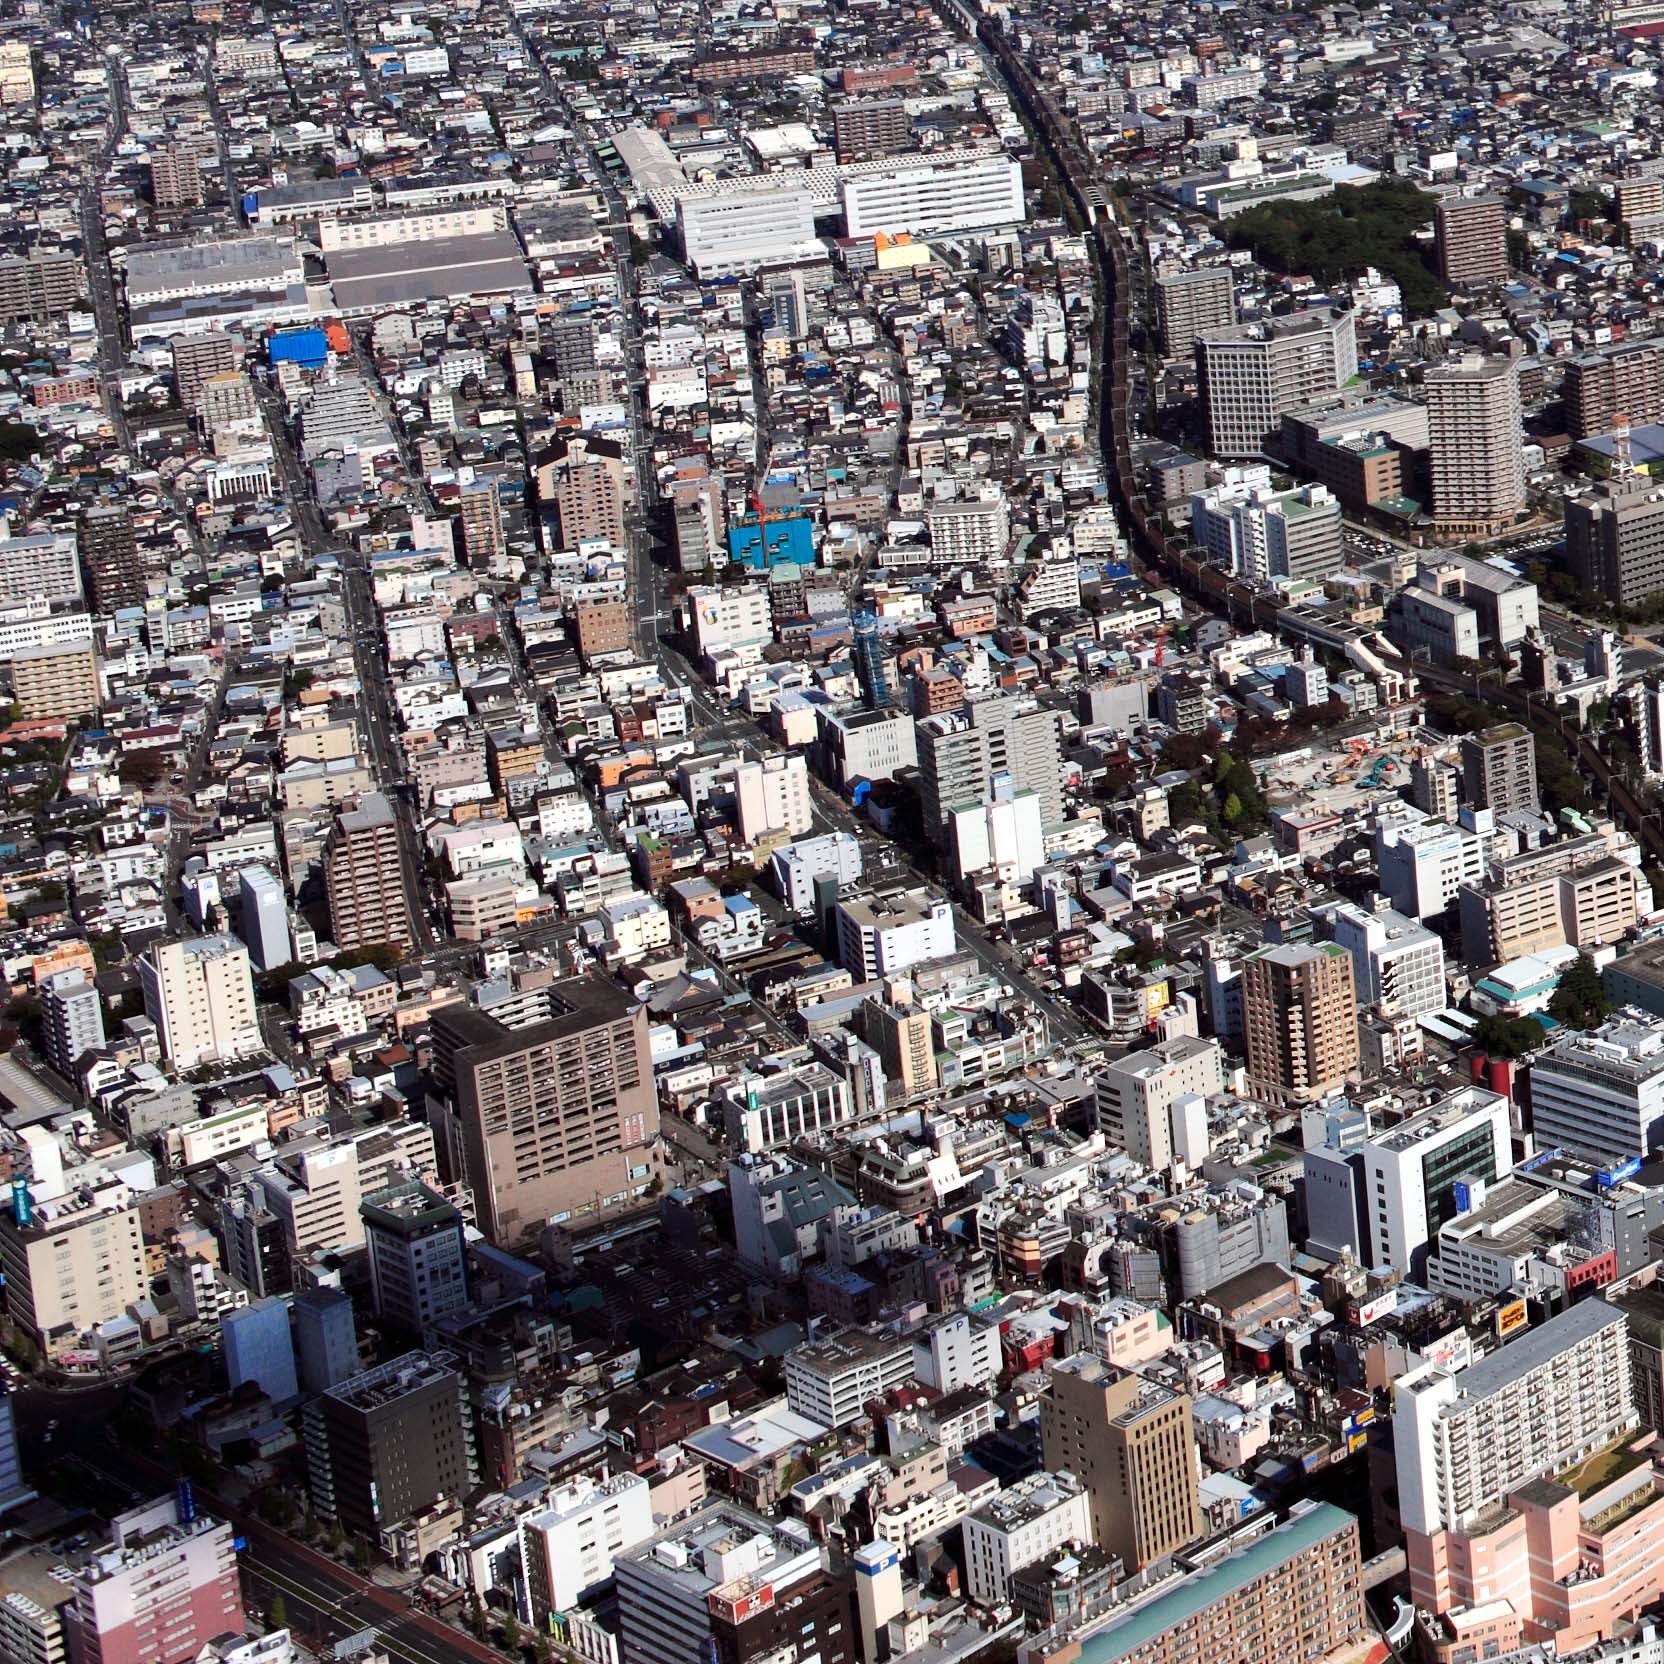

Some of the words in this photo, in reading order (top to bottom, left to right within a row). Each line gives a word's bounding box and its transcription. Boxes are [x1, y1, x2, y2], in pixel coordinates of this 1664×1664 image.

[937, 908, 946, 919] P
[956, 1320, 964, 1331] P
[879, 1558, 889, 1571] P
